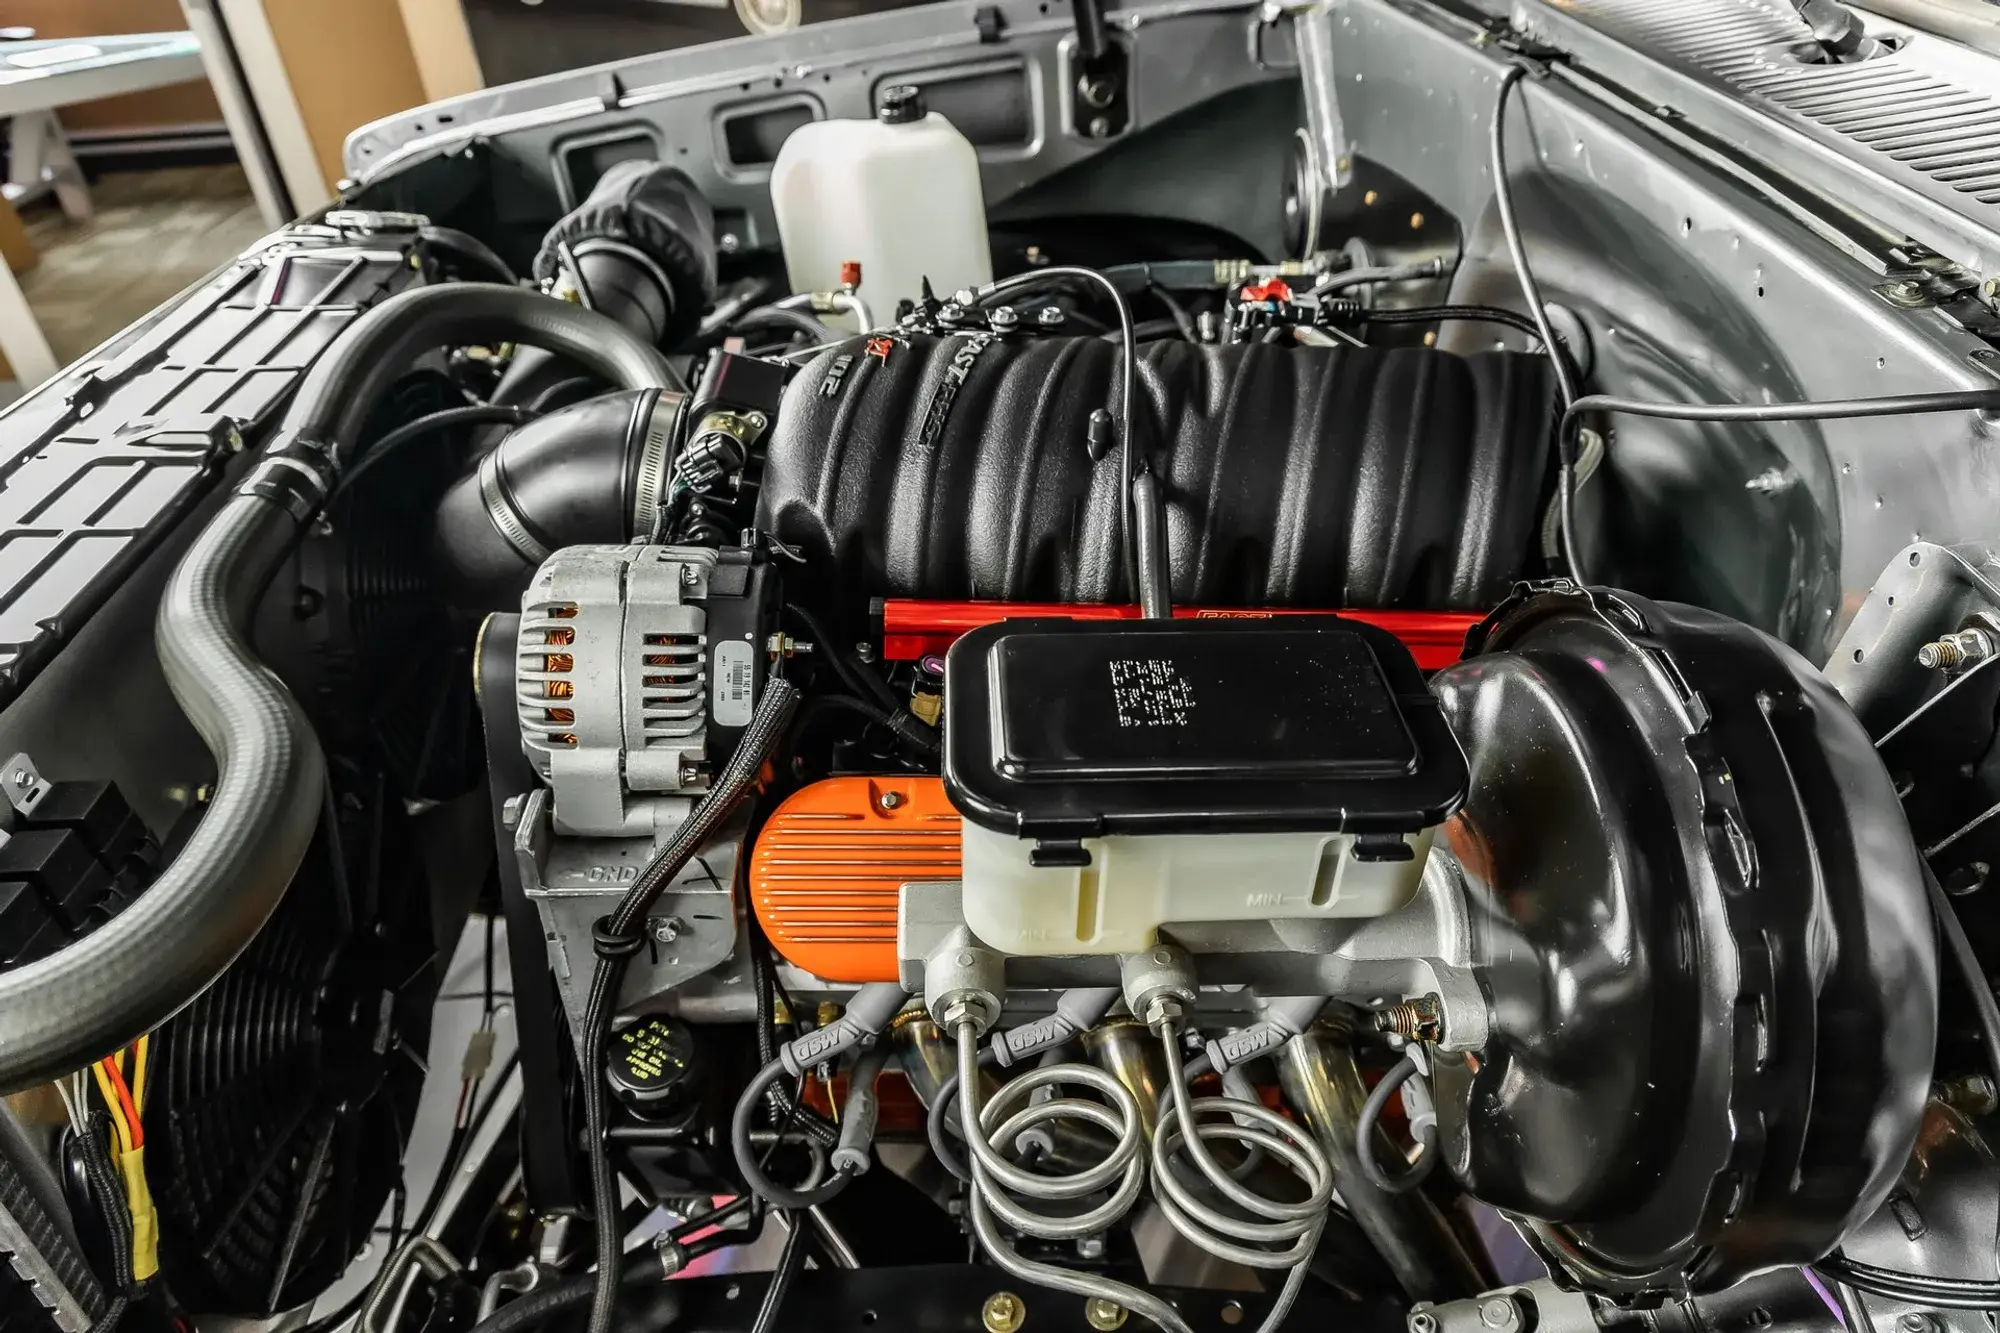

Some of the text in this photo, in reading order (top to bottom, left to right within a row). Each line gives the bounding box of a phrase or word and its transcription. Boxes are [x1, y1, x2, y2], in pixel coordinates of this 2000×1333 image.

[588, 866, 639, 883] GND
[1246, 893, 1283, 907] MIN
[799, 1024, 842, 1061] MSD
[1011, 1024, 1056, 1051] MSD
[1227, 1030, 1270, 1060] MSD
